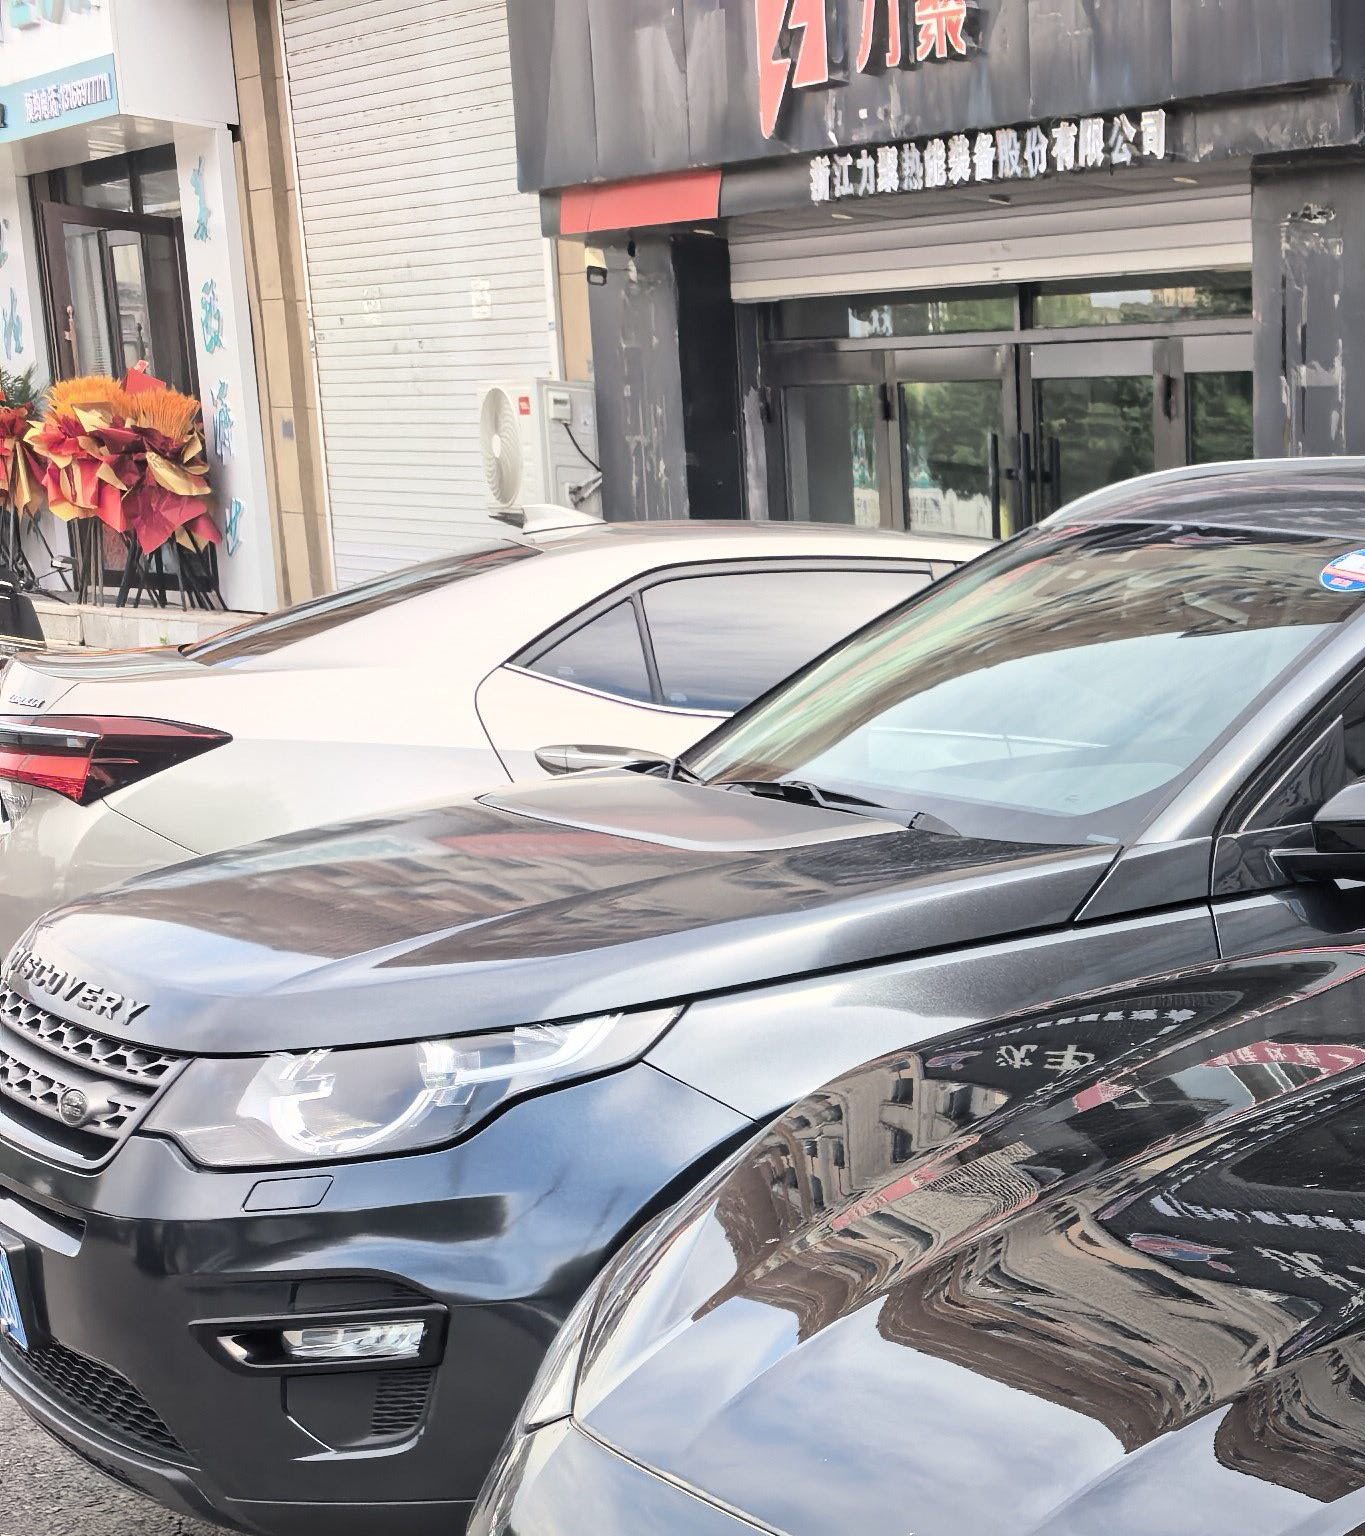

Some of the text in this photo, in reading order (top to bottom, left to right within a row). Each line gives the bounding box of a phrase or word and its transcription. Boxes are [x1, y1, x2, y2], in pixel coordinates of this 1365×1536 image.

[809, 108, 1166, 206] 浙江力聚热能装备股份有限公司
